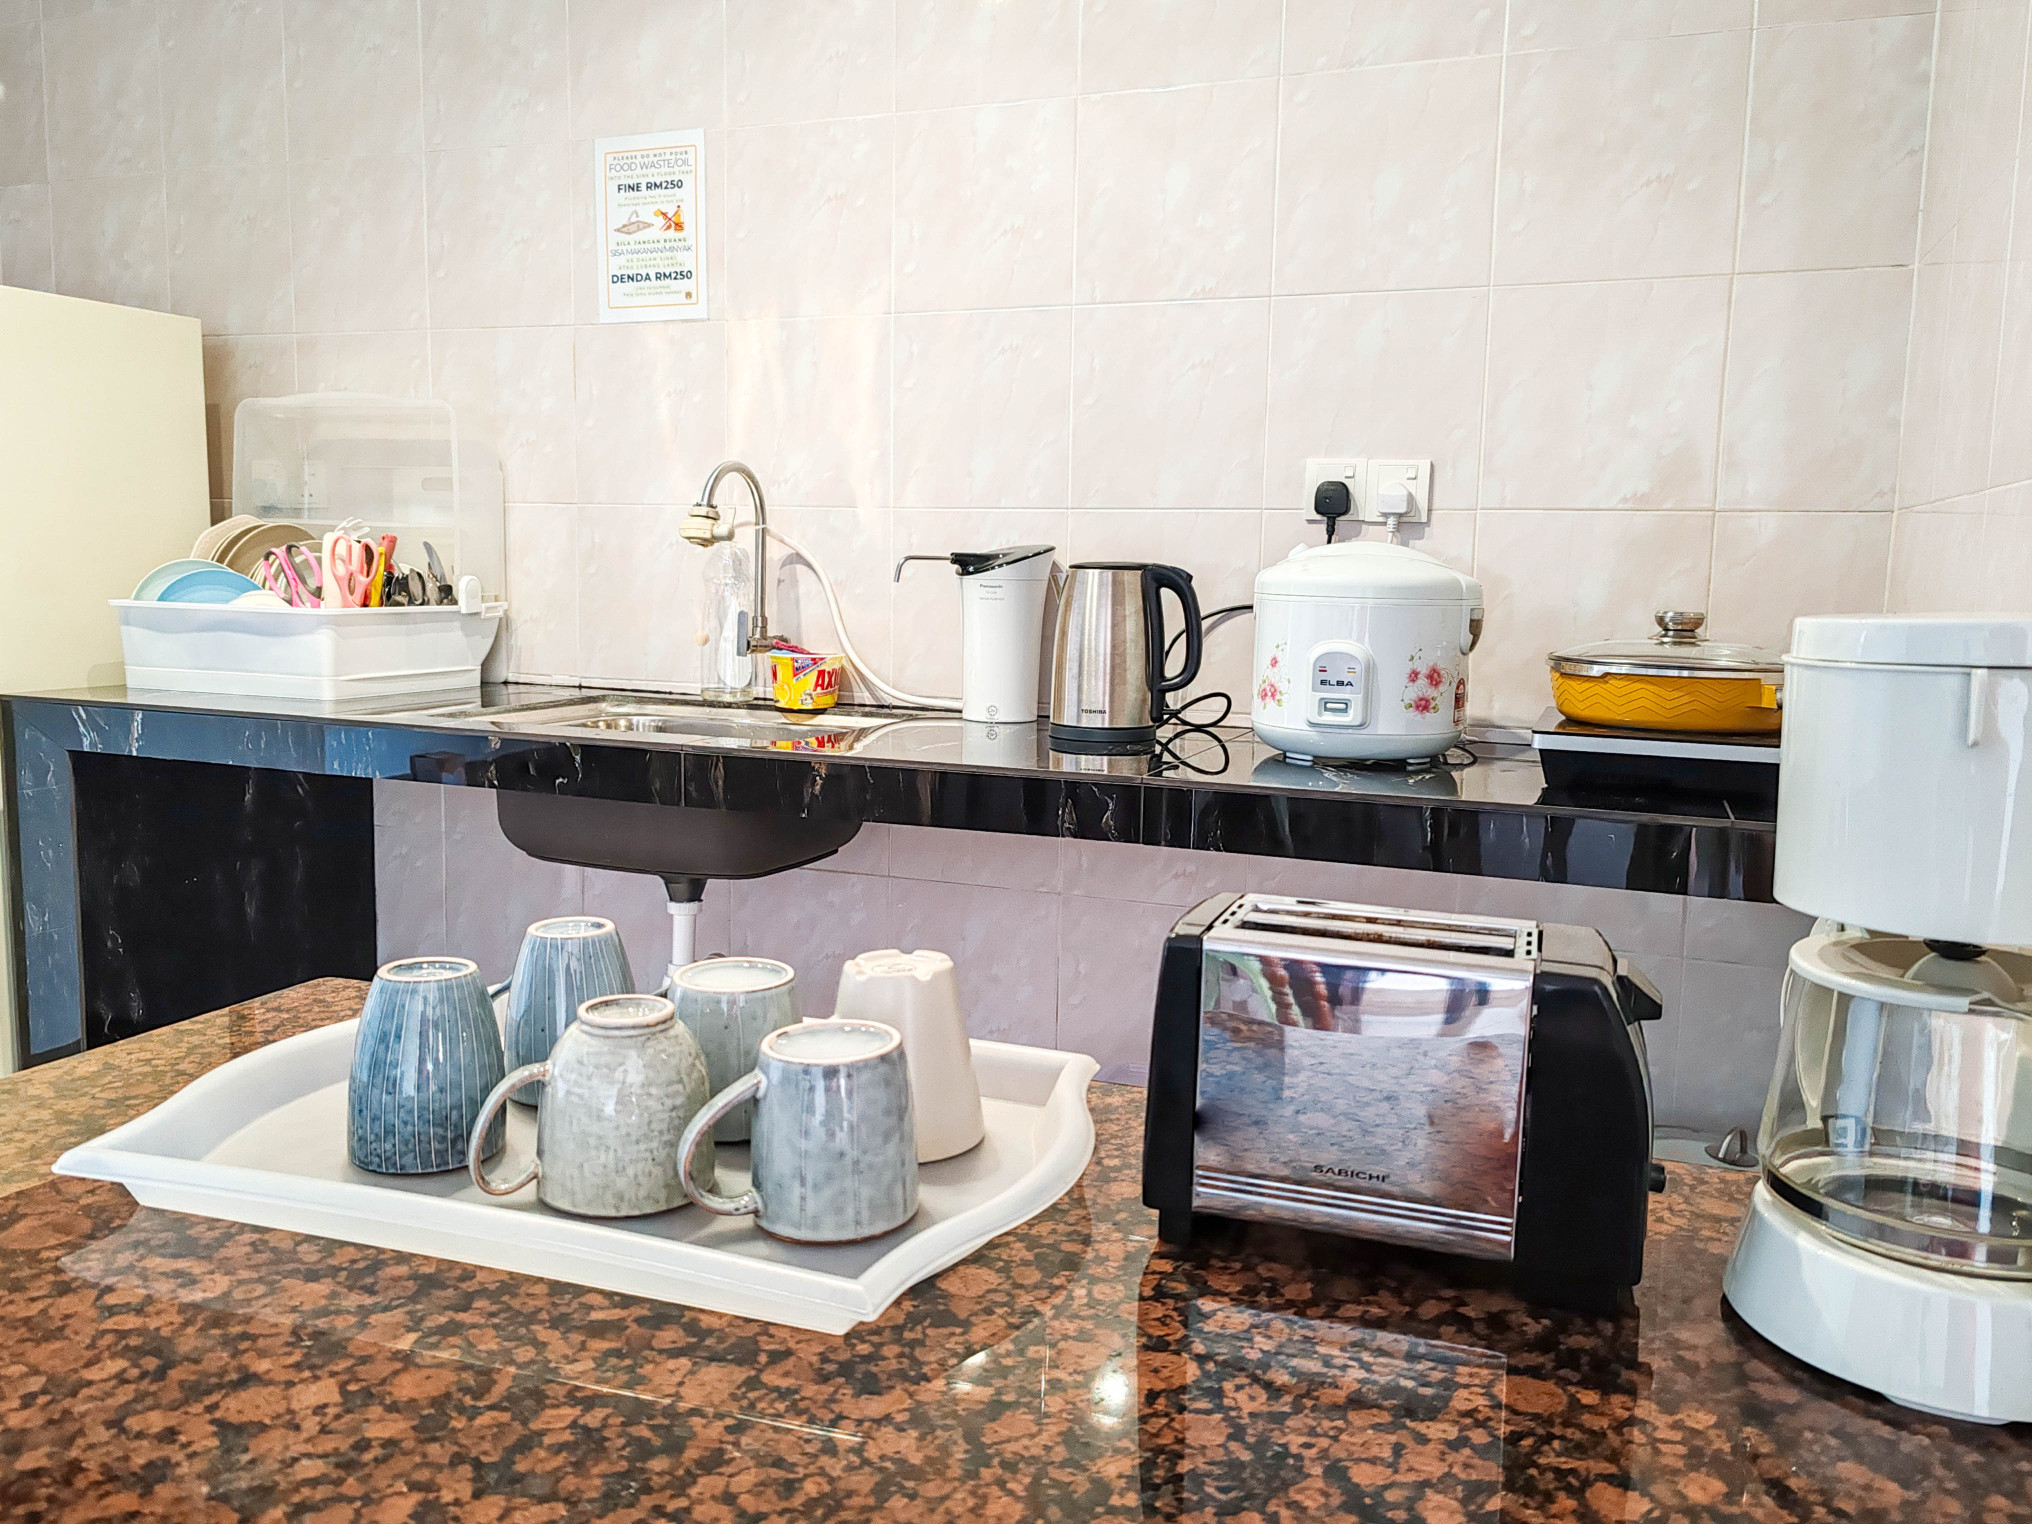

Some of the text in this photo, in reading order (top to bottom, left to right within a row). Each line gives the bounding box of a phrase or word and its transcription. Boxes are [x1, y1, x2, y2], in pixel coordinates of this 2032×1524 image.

[608, 157, 692, 173] FOOD WASTE/OIL
[617, 179, 683, 193] FINE RM250
[610, 249, 625, 257] SISA
[611, 270, 693, 284] DENDA RM250
[1320, 679, 1354, 687] ELBA
[1313, 1164, 1387, 1183] SABICHI
